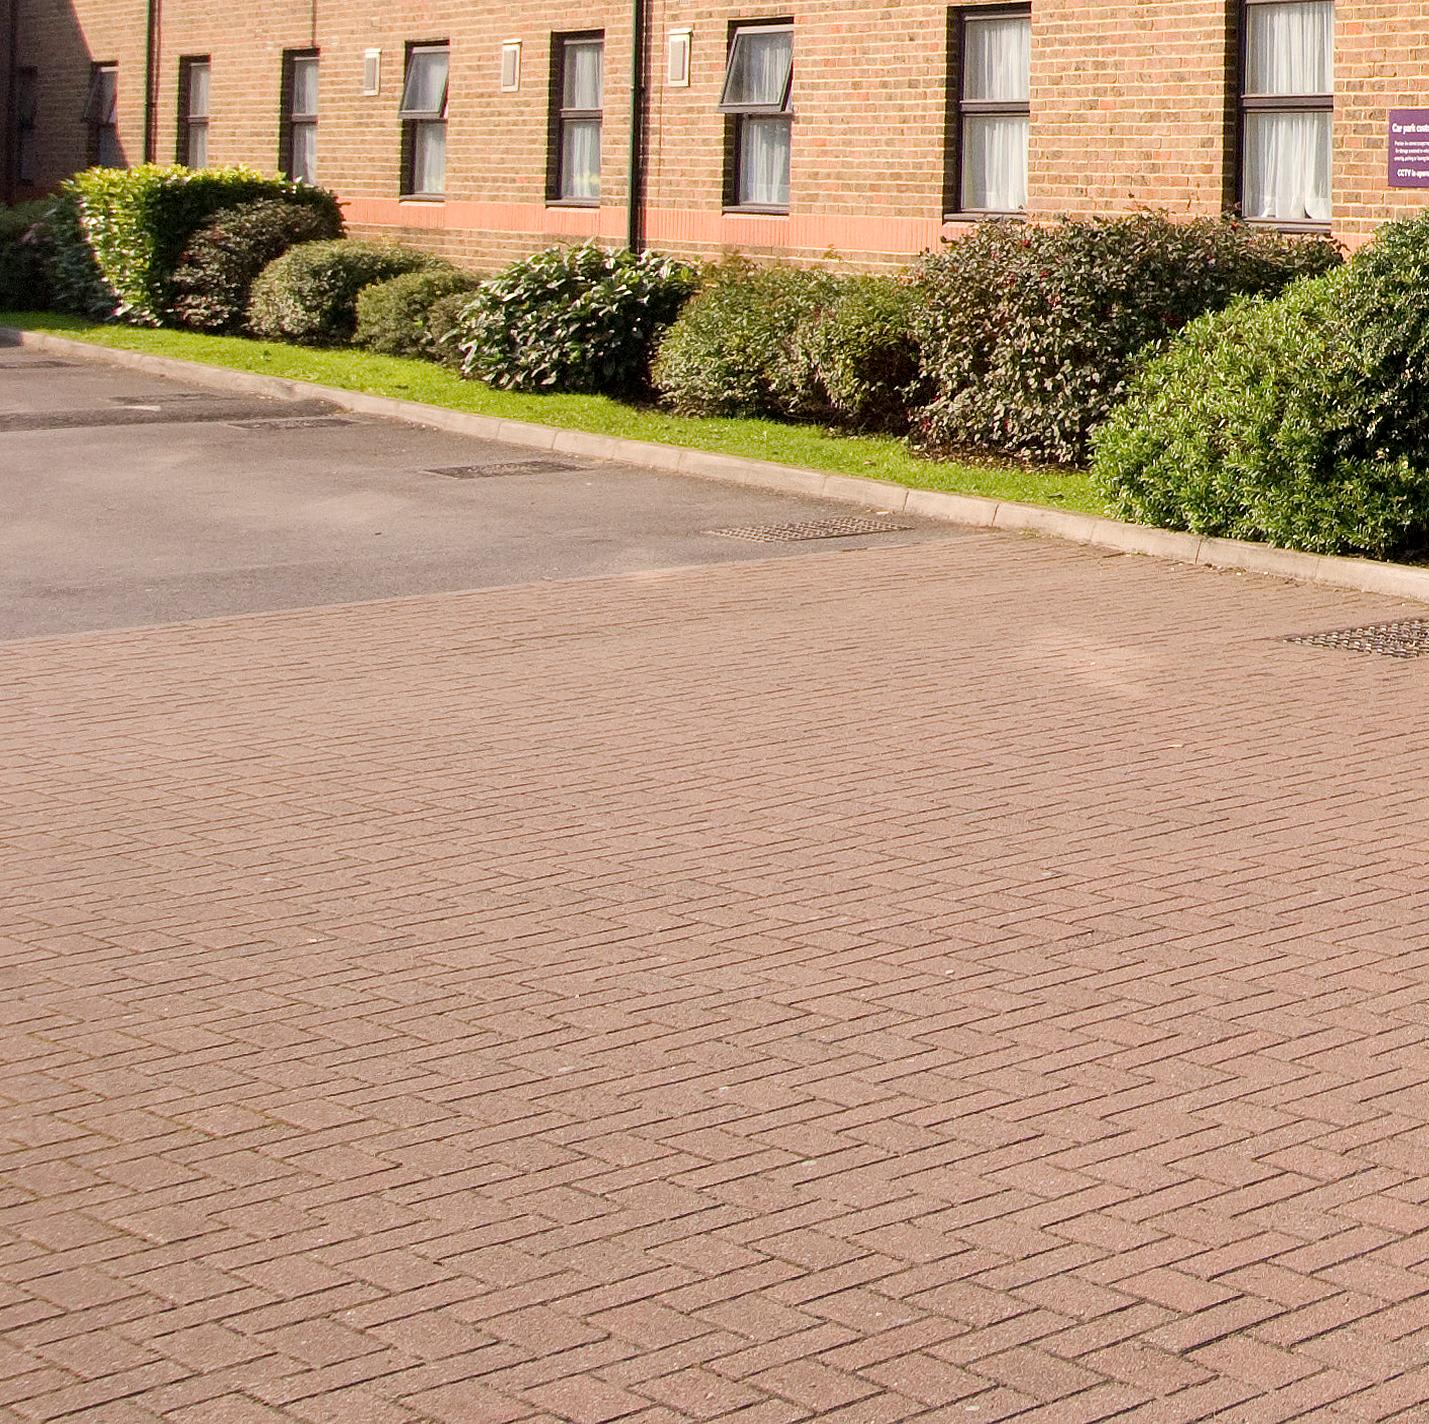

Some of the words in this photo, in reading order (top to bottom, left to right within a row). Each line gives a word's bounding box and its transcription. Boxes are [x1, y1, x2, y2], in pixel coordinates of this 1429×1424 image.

[1392, 123, 1402, 133] Car
[1403, 123, 1416, 135] park
[1397, 169, 1411, 177] CCTV
